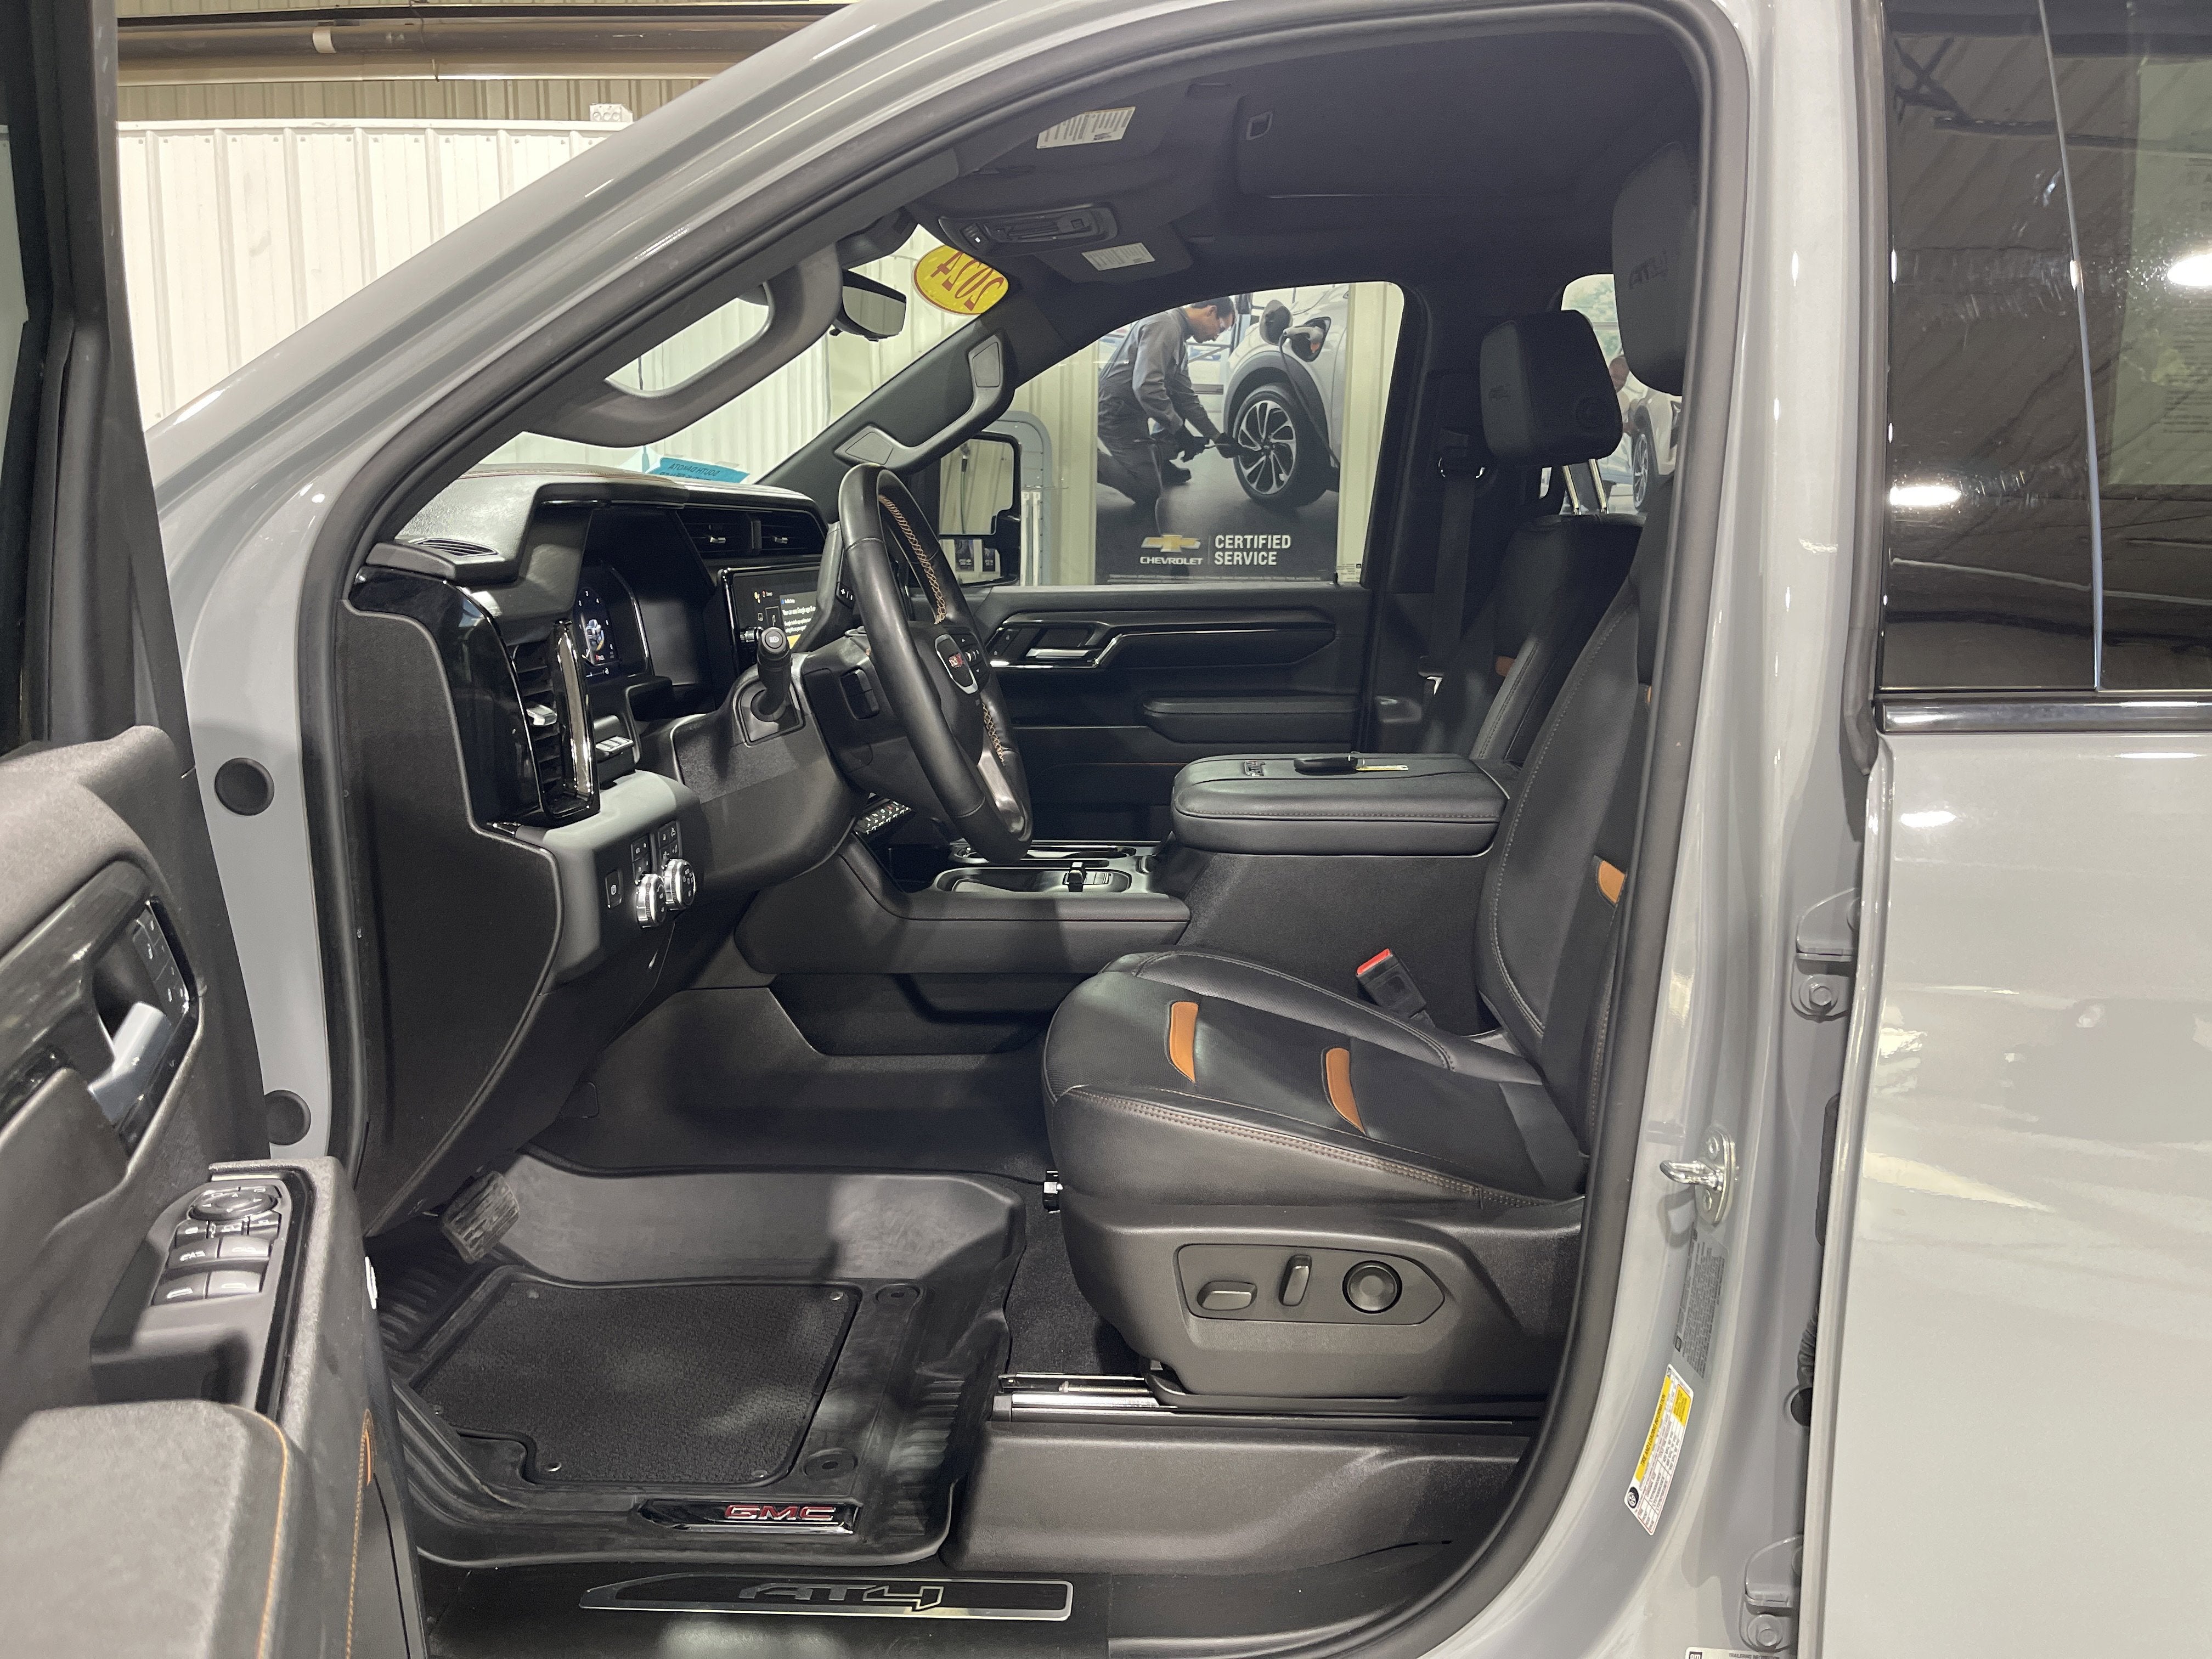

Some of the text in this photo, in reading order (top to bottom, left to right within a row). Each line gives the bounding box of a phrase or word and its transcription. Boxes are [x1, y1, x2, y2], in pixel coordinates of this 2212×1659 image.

[1214, 534, 1291, 549] CERTIFIED
[1139, 556, 1203, 565] CHEVROLET
[1214, 551, 1277, 566] SERVICE
[725, 1504, 837, 1521] GMC
[738, 1583, 944, 1612] AT4
